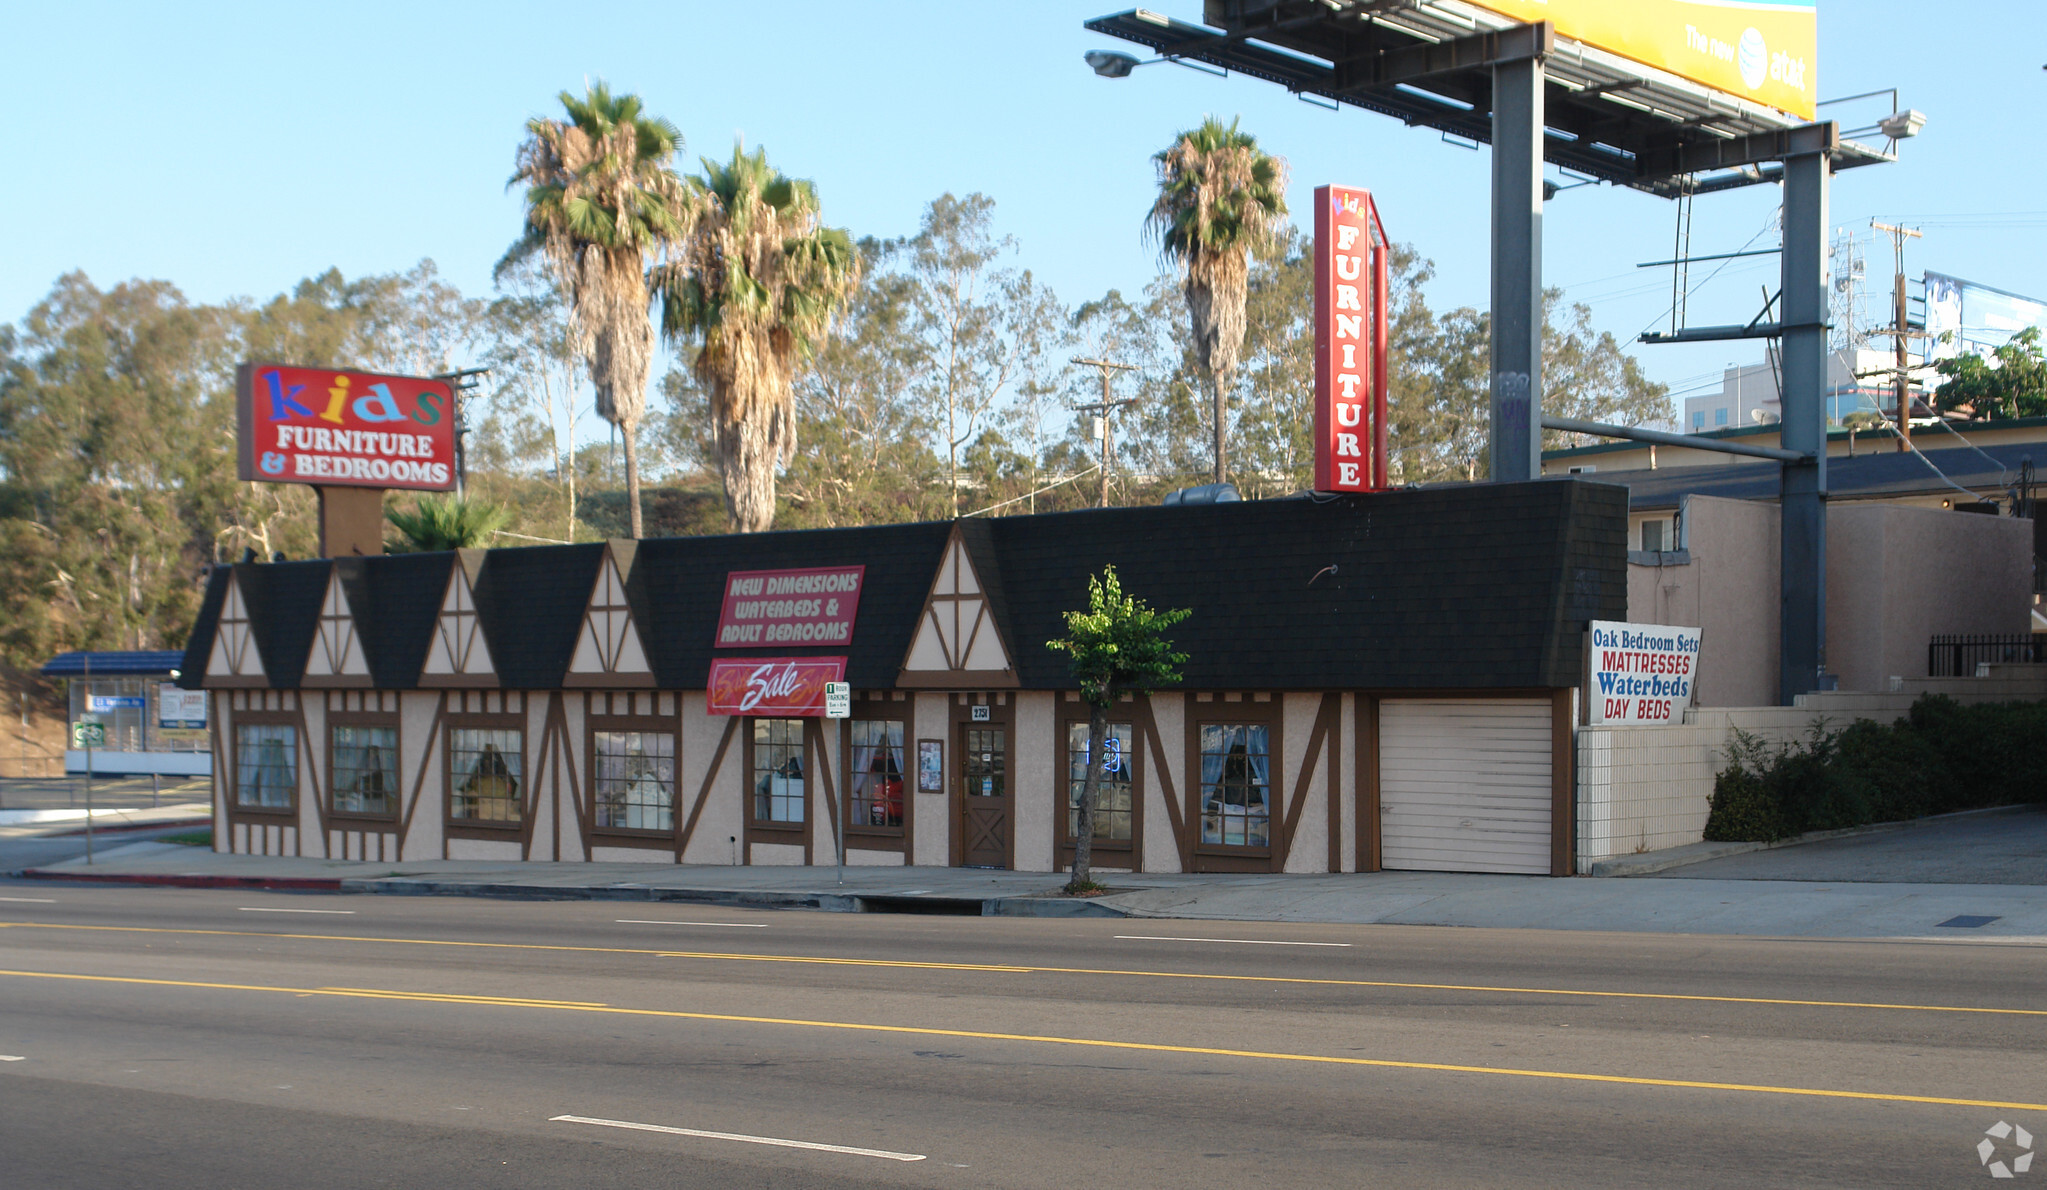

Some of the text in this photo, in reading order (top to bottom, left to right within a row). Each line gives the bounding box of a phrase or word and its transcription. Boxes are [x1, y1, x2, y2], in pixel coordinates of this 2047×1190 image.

[1685, 24, 1734, 63] The new
[1333, 192, 1365, 219] kids
[1335, 224, 1362, 486] FURNITURE
[262, 370, 444, 426] kids
[276, 424, 434, 458] FURNITURE
[260, 451, 449, 484] & BEDROOMS
[730, 573, 859, 597] NEW DIMENSIONS
[734, 598, 839, 619] WATERBEDS &
[720, 622, 849, 642] ADULT BEDROOMS
[1593, 628, 1699, 653] Oak Bedroom Sets
[1602, 651, 1690, 675] MATTRESSES
[740, 661, 801, 711] Sale
[1597, 672, 1688, 697] Waterbeds
[1604, 698, 1671, 719] DAY BEDS
